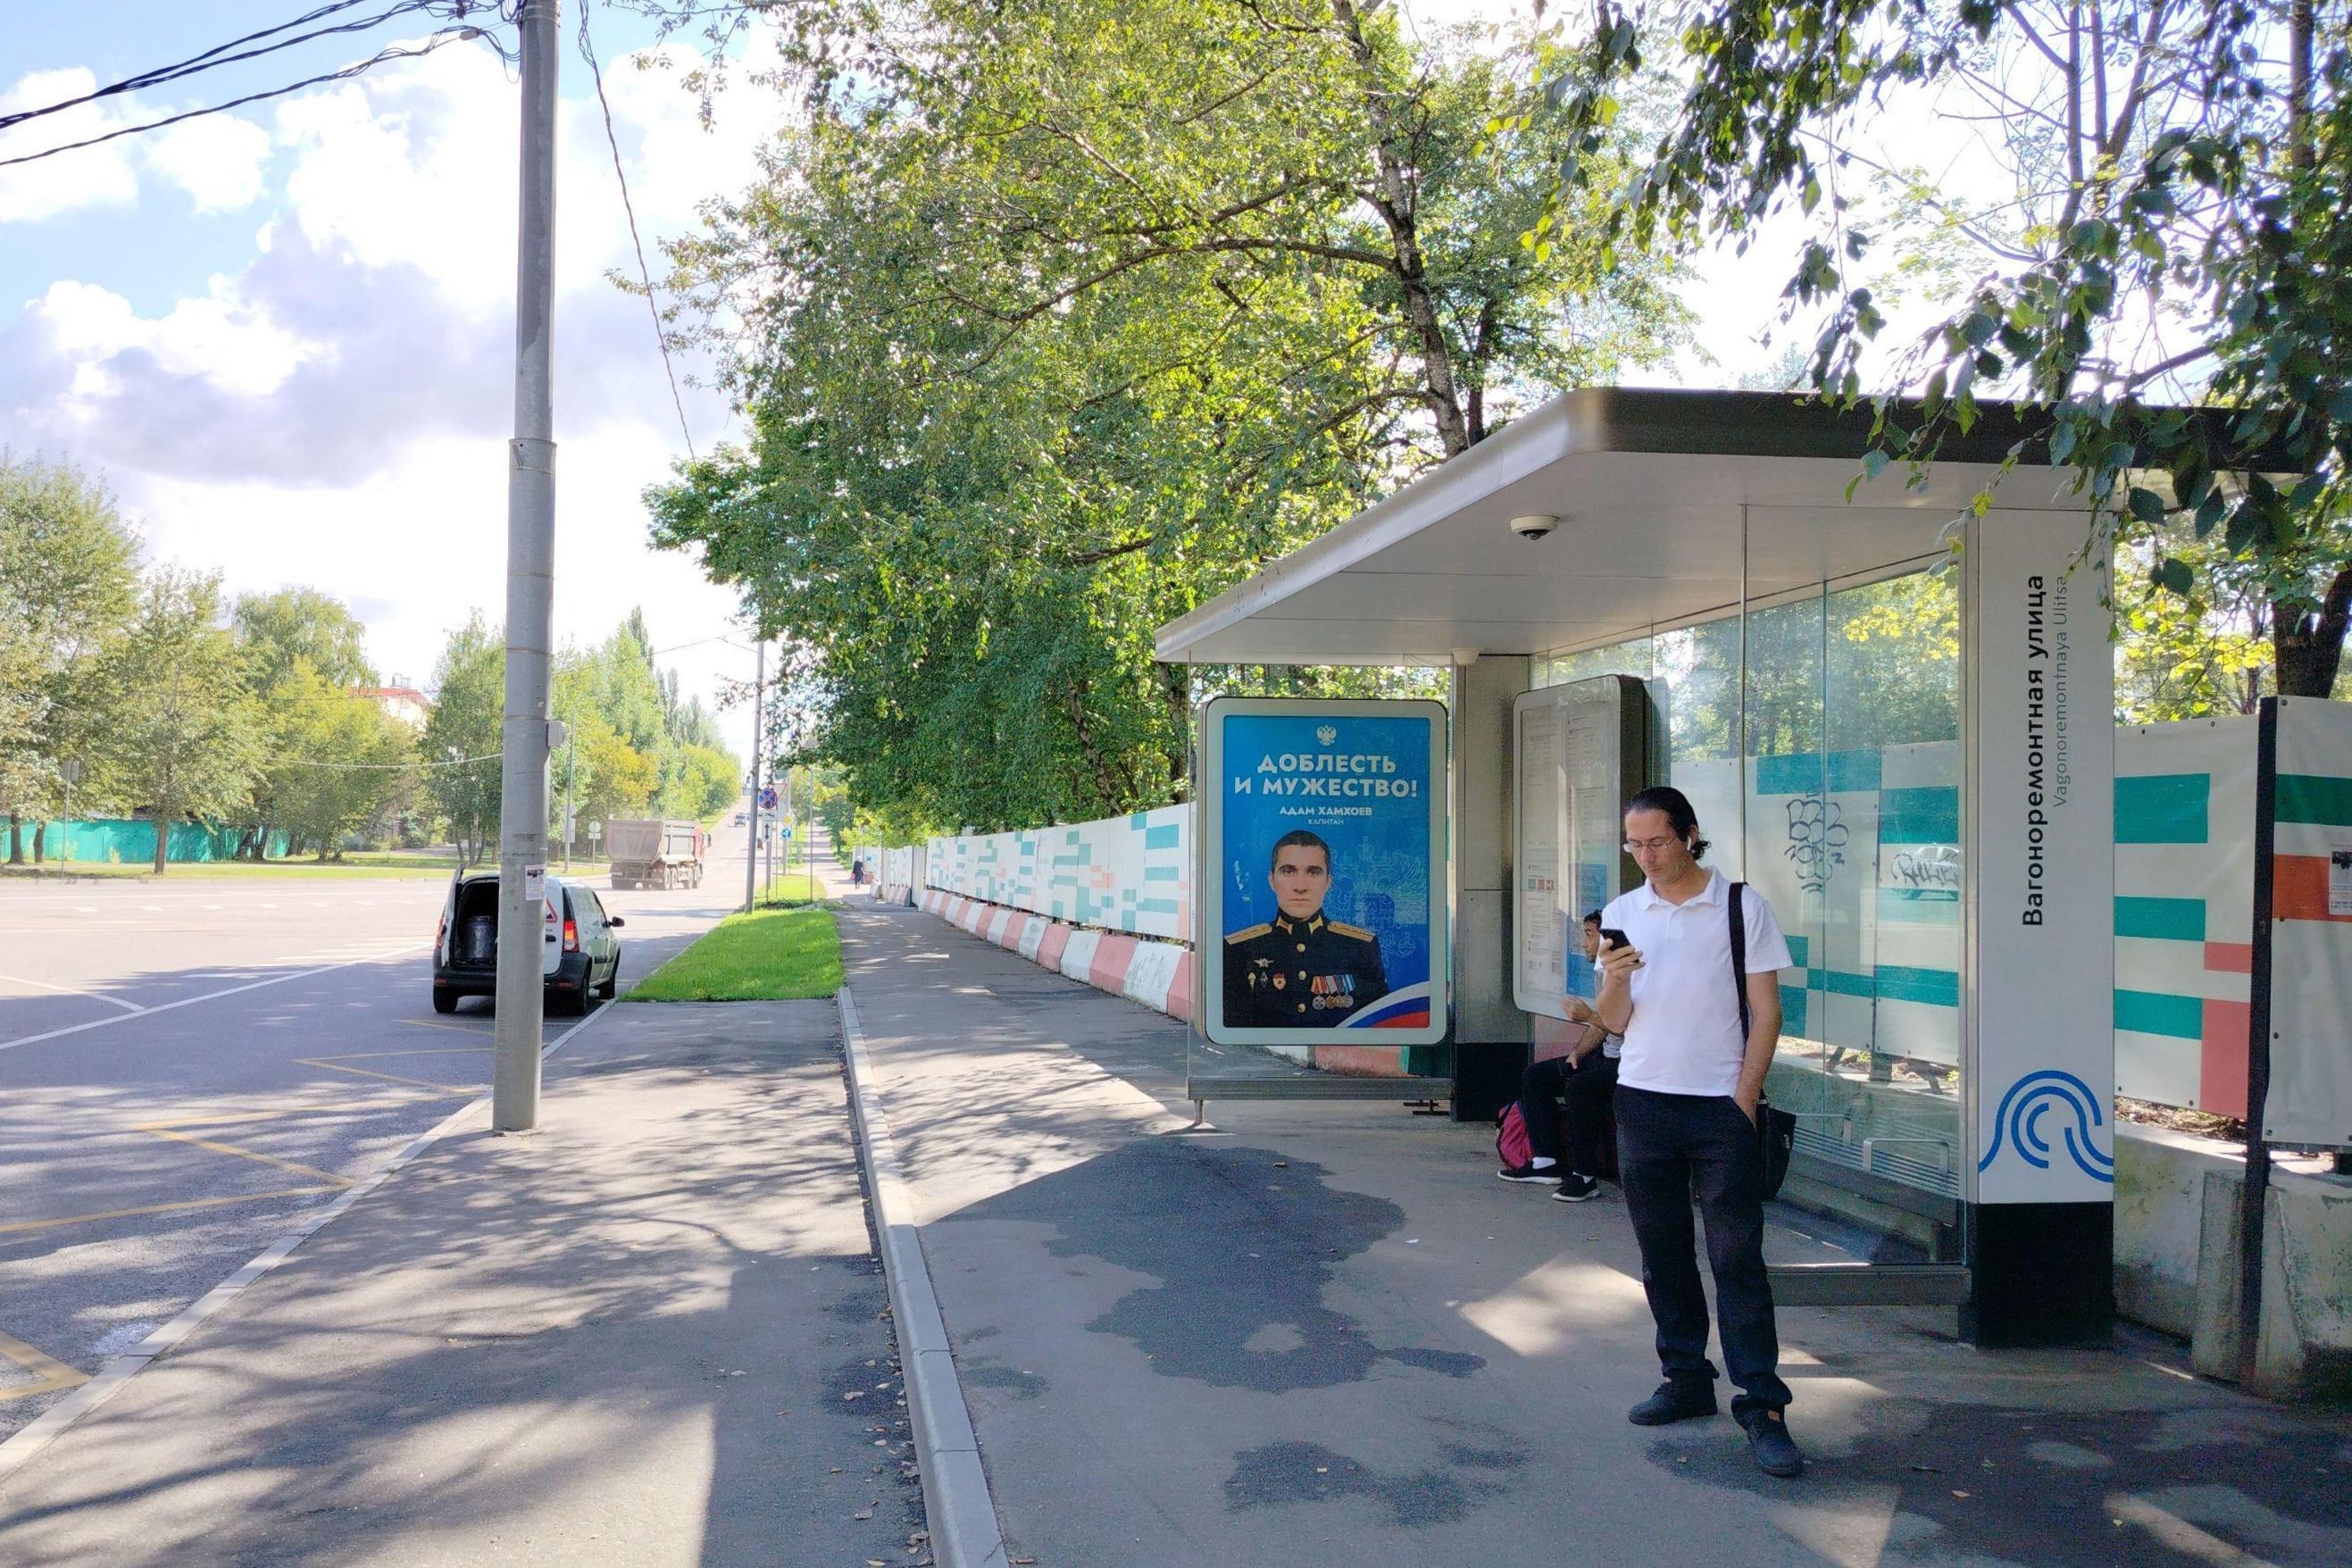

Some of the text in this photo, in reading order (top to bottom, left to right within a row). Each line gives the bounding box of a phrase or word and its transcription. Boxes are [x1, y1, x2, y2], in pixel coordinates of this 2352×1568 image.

[2052, 576, 2071, 808] Vagonoremontnaya Ulitsa
[2023, 575, 2048, 926] Вагоноремонтная улица
[1257, 754, 1397, 773] ДОБЛЕСТЬ
[1234, 776, 1418, 797] И МУЖЕСТВО!
[1279, 805, 1372, 816] АДАМ ХАМХОЕВ
[1307, 818, 1344, 826] КАПИТАН
